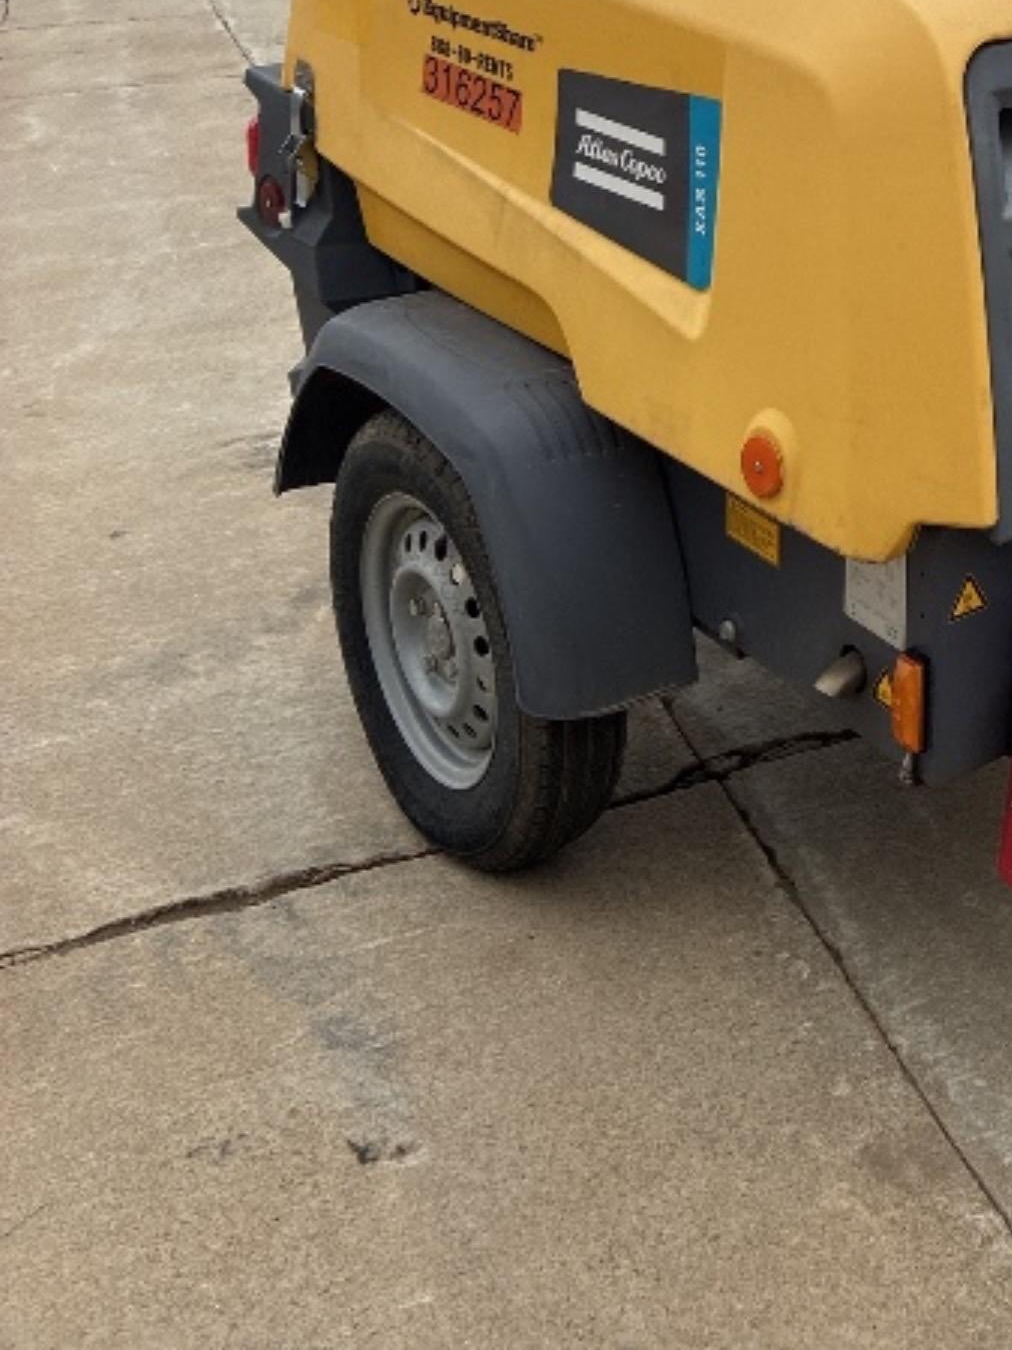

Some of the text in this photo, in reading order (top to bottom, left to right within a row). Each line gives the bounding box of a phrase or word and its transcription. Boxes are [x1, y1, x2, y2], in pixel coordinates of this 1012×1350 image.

[424, 55, 522, 128] 316257
[575, 134, 667, 185] Atlas Copco
